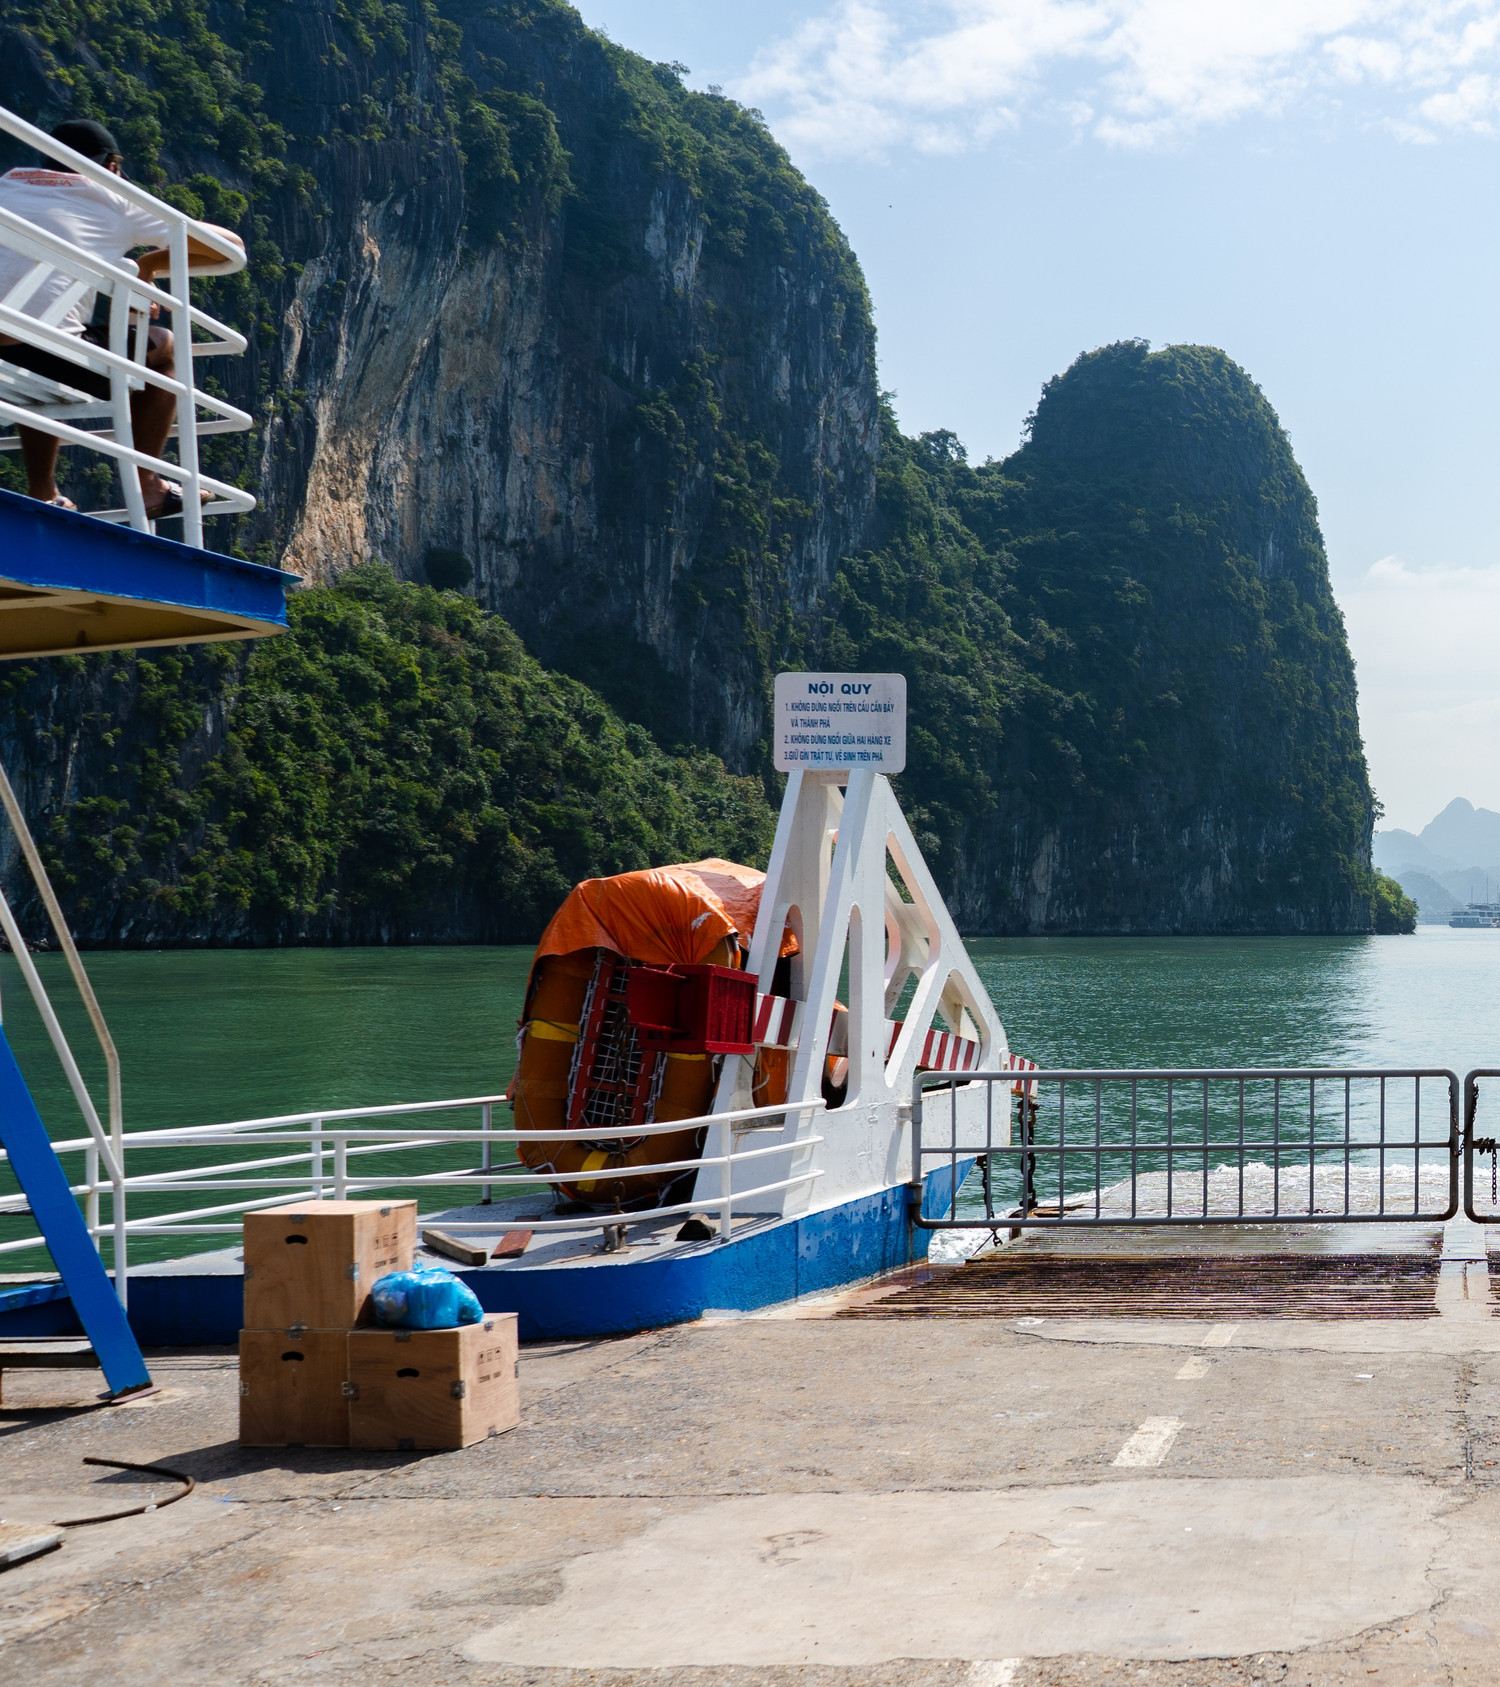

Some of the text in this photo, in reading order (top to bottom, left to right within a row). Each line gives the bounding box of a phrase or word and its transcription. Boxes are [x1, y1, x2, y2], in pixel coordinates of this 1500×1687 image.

[808, 680, 872, 698] NỘI QUY
[791, 700, 811, 713] KHÔNG
[843, 700, 857, 713] TRÊN
[784, 735, 790, 744] 2.
[791, 733, 810, 744] KHÔNG
[857, 735, 867, 745] HAI
[883, 735, 891, 745] XE
[843, 751, 856, 761] SINH
[857, 750, 871, 761] TRÊN
